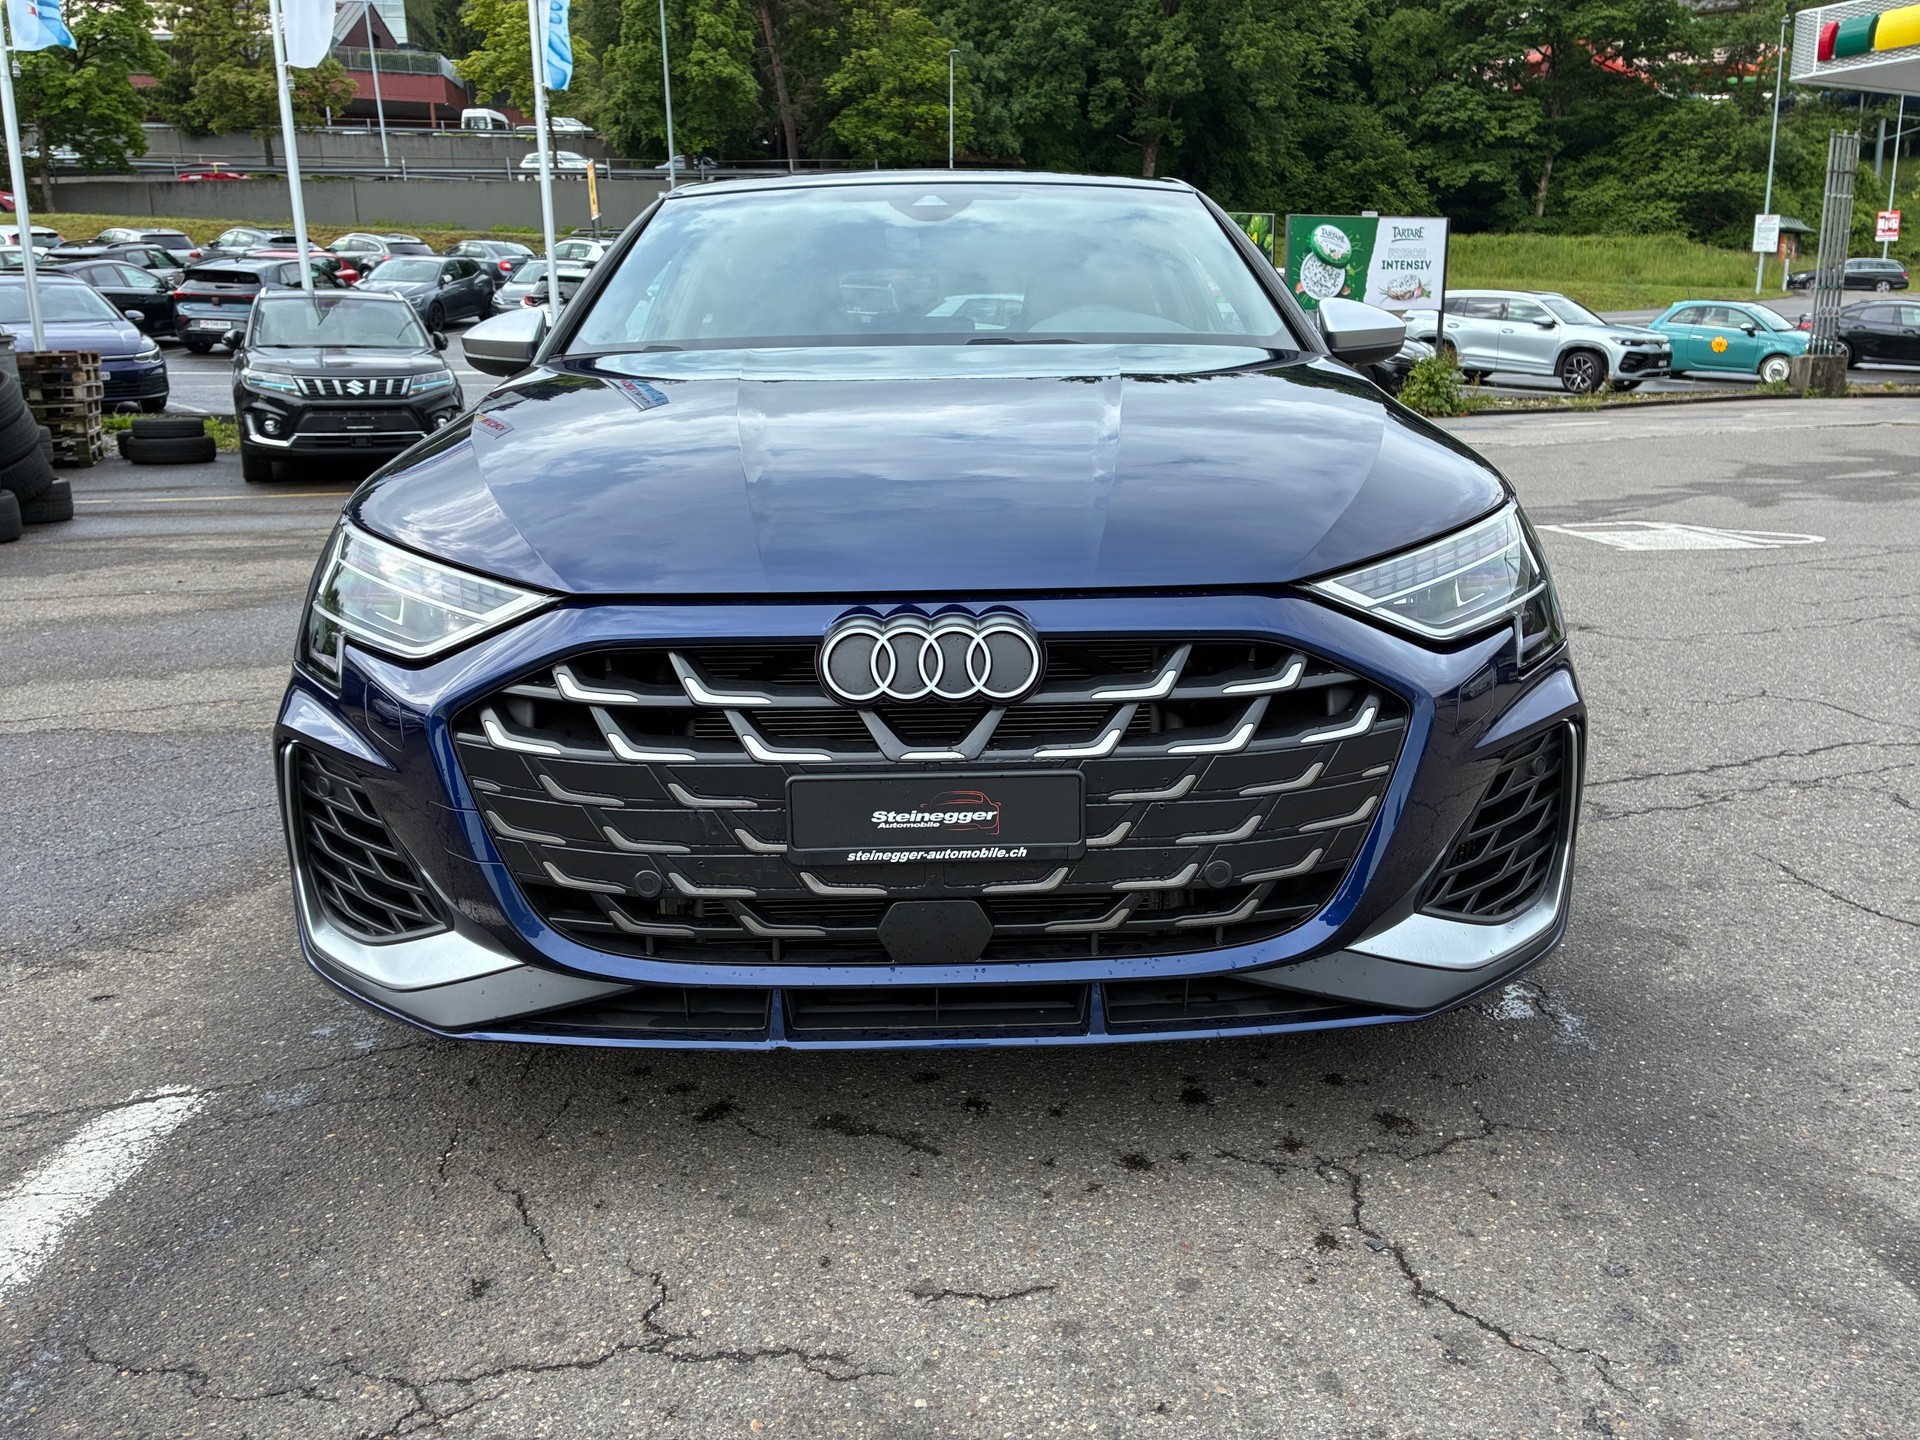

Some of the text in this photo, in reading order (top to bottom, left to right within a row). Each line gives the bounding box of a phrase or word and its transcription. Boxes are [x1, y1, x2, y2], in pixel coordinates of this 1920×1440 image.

[1392, 226, 1425, 239] TARTARE
[1381, 260, 1432, 270] INTENSIV
[871, 810, 998, 824] Steinegger
[847, 847, 1028, 863] steinegger-automobile.ch
